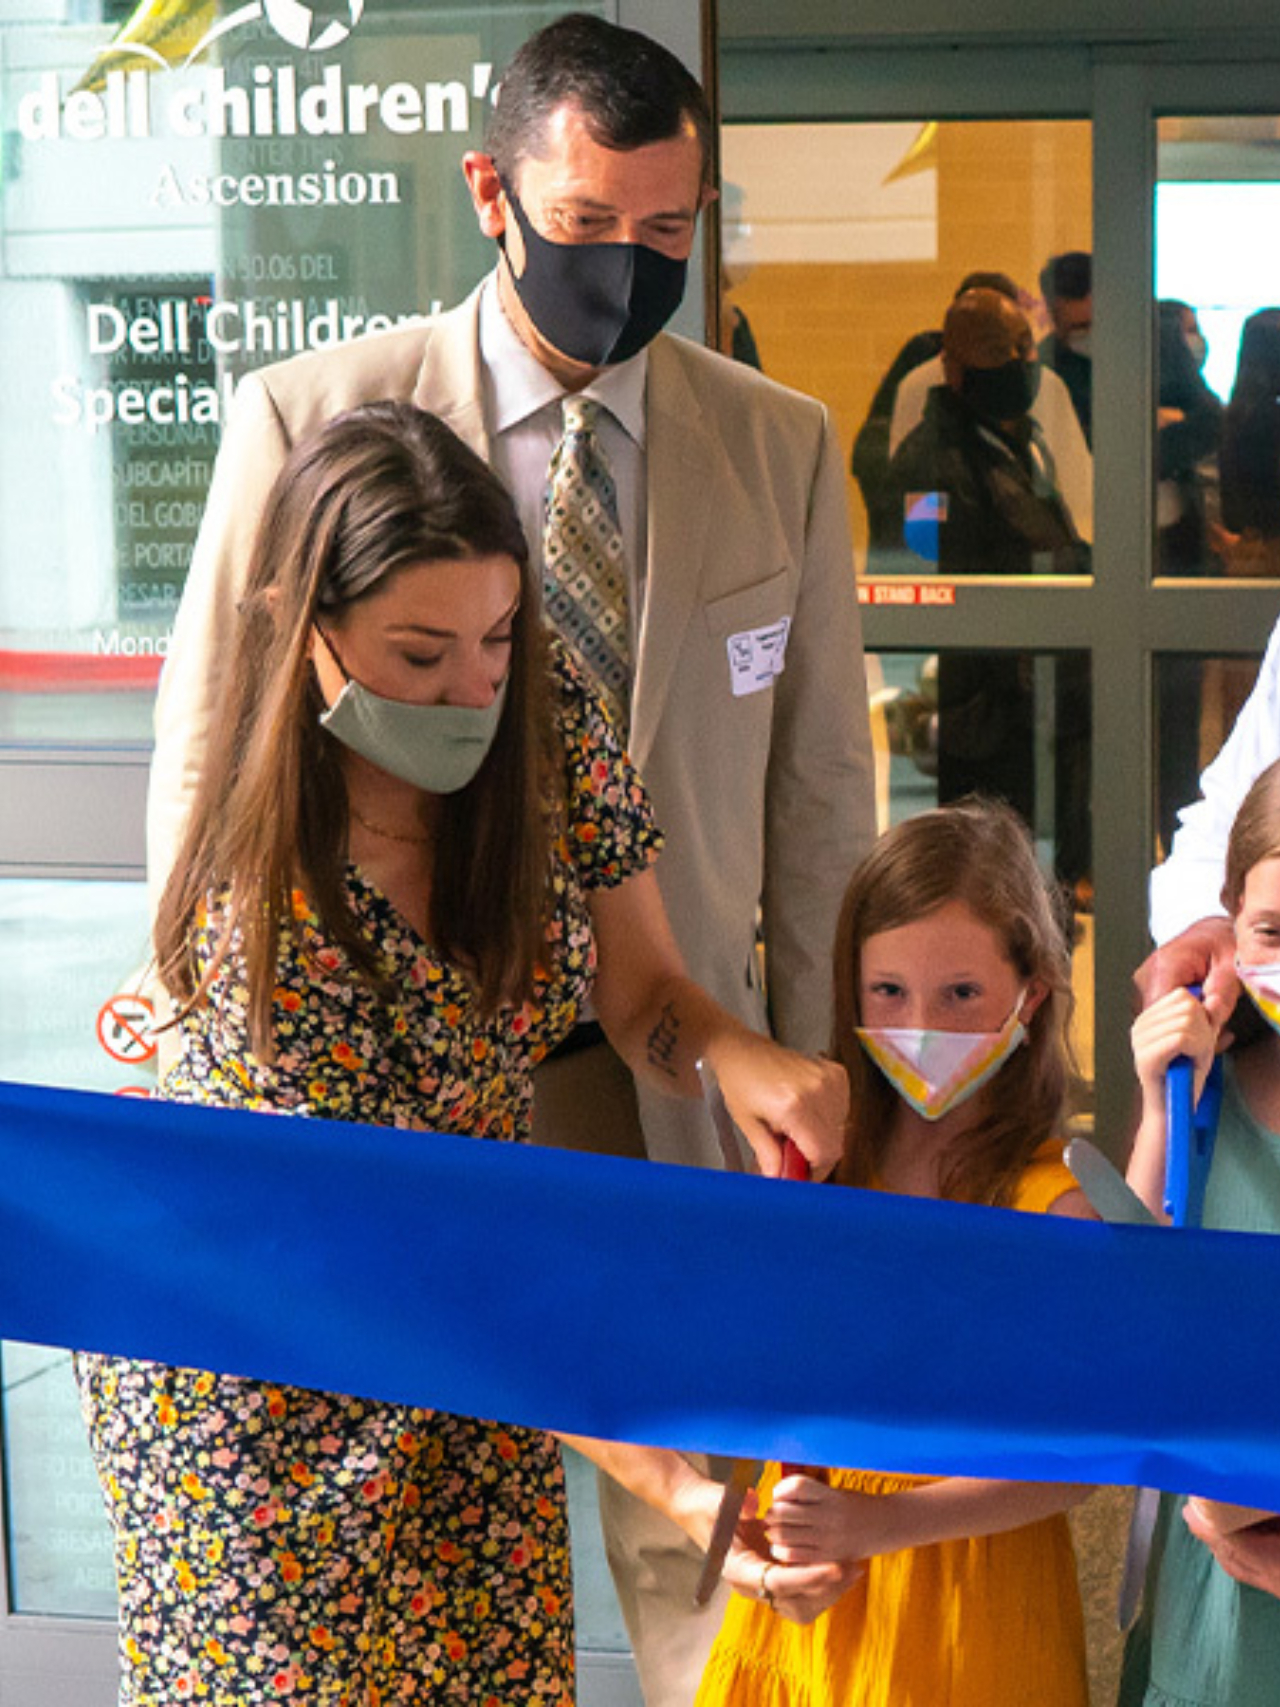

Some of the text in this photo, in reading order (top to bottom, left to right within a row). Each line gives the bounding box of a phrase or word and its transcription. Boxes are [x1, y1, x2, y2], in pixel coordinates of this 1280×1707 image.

[18, 69, 150, 140] dell
[151, 158, 402, 207] Ascension
[300, 253, 338, 280] DEL
[87, 299, 191, 353] Dell
[51, 372, 234, 434] Special
[920, 585, 954, 603] BACK
[94, 626, 169, 657] Mond
